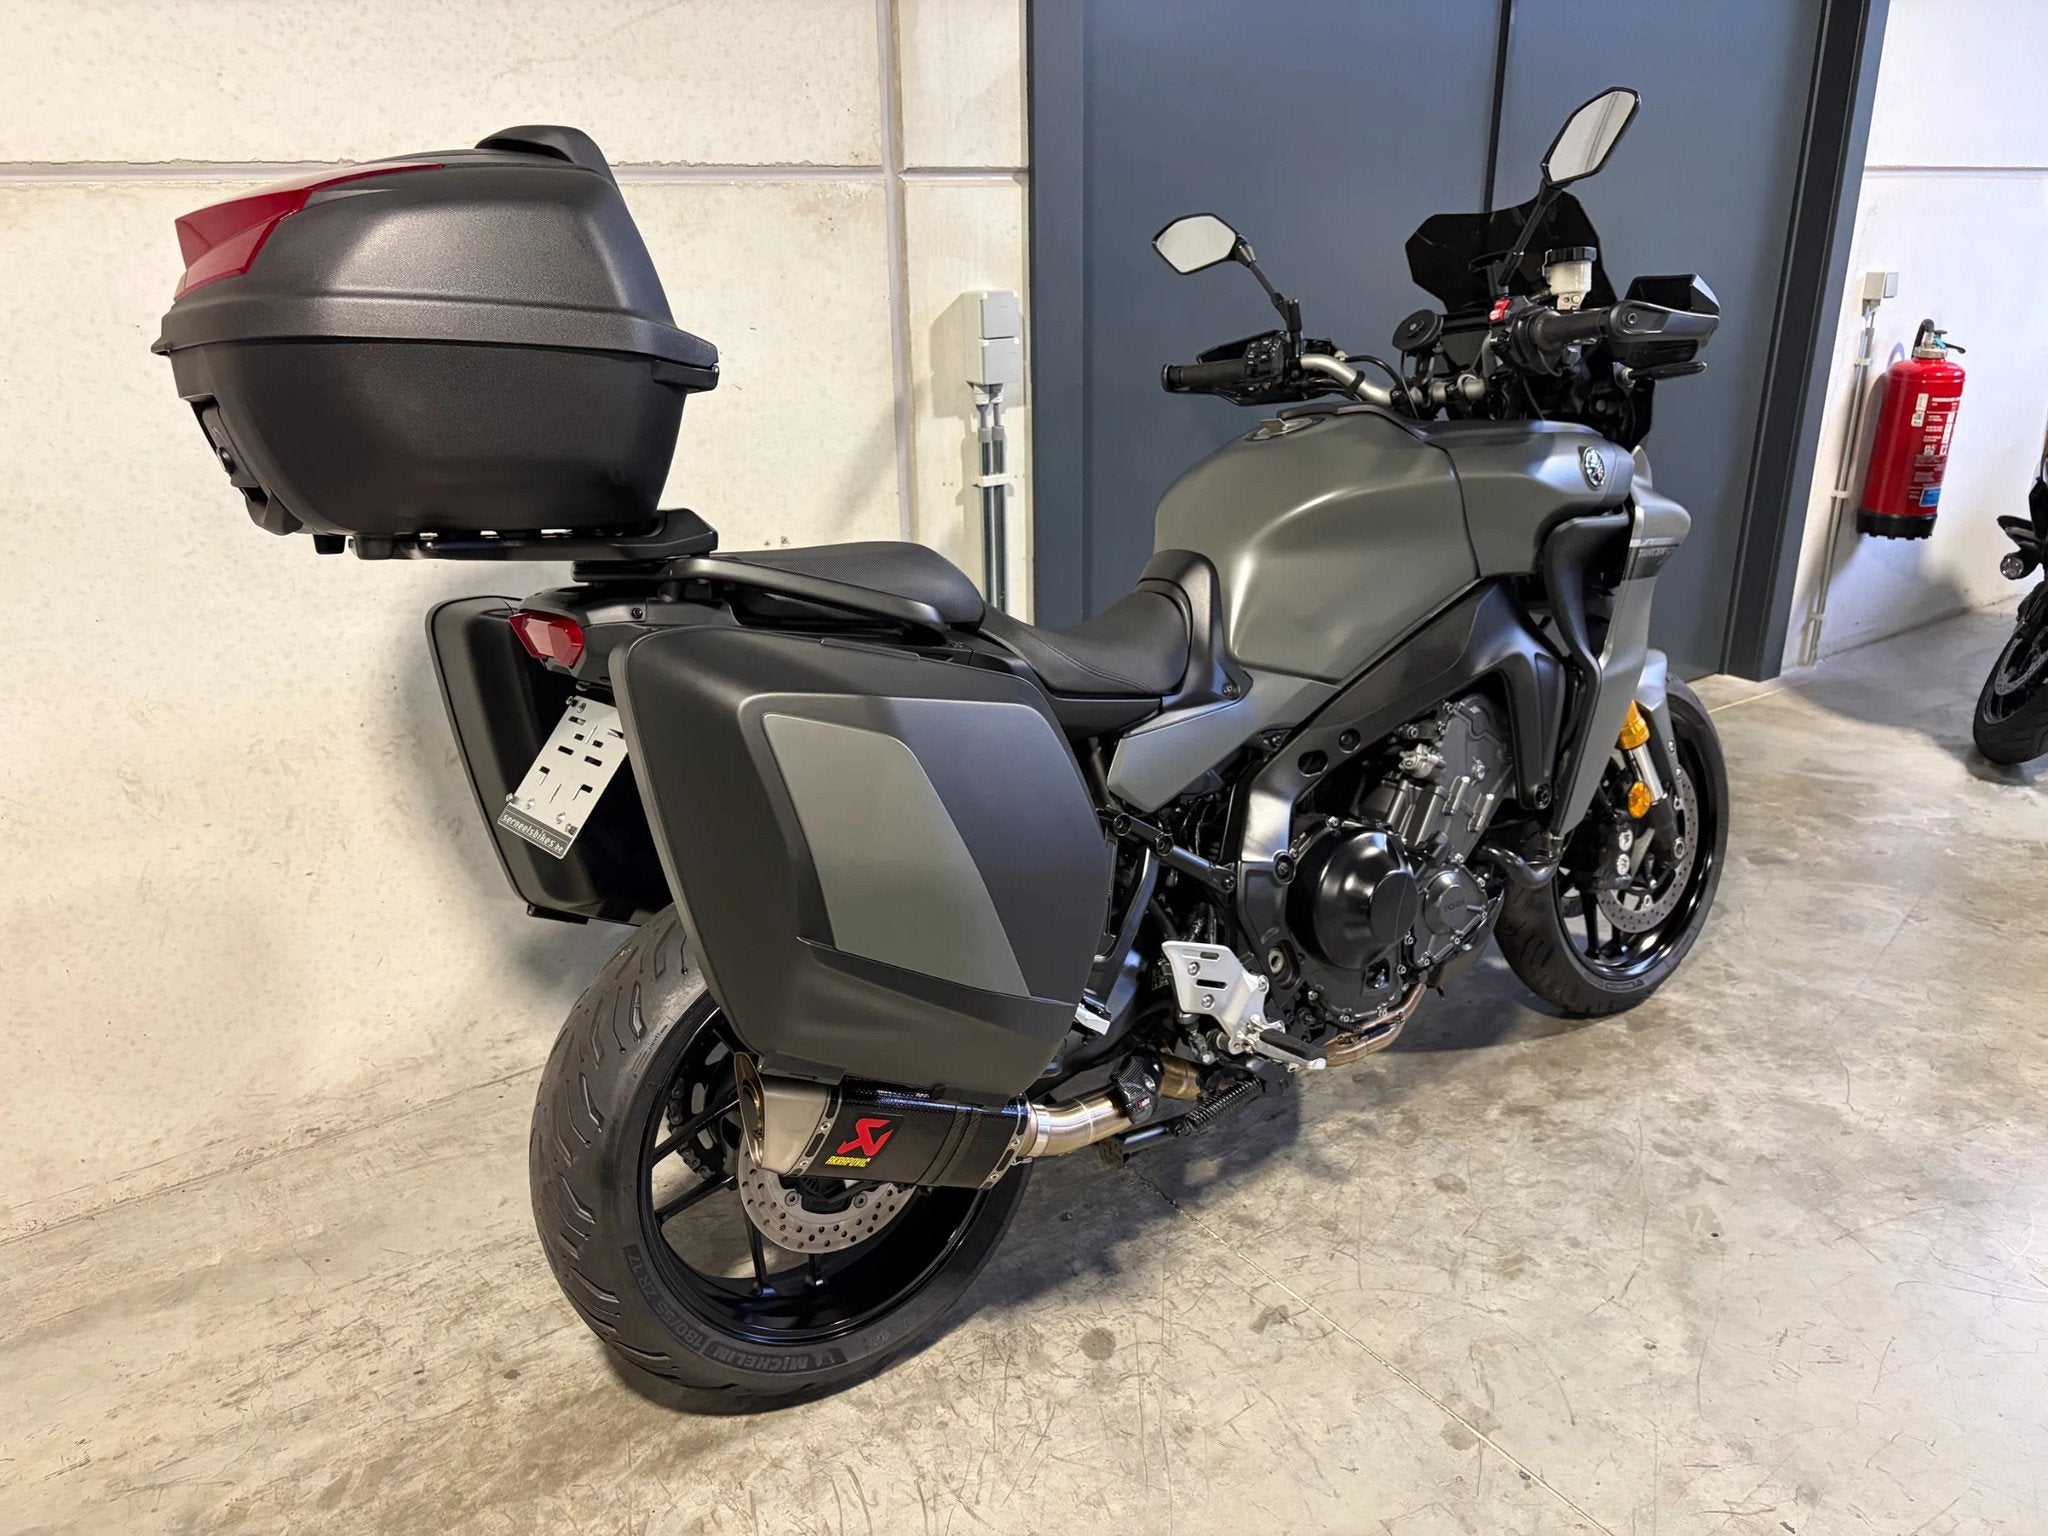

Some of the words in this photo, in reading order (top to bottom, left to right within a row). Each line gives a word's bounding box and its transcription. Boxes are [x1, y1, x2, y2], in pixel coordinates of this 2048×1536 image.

[502, 814, 563, 853] serneelsbikes.be
[657, 1305, 705, 1351] 180/55
[714, 1343, 809, 1371] MICHELIN
